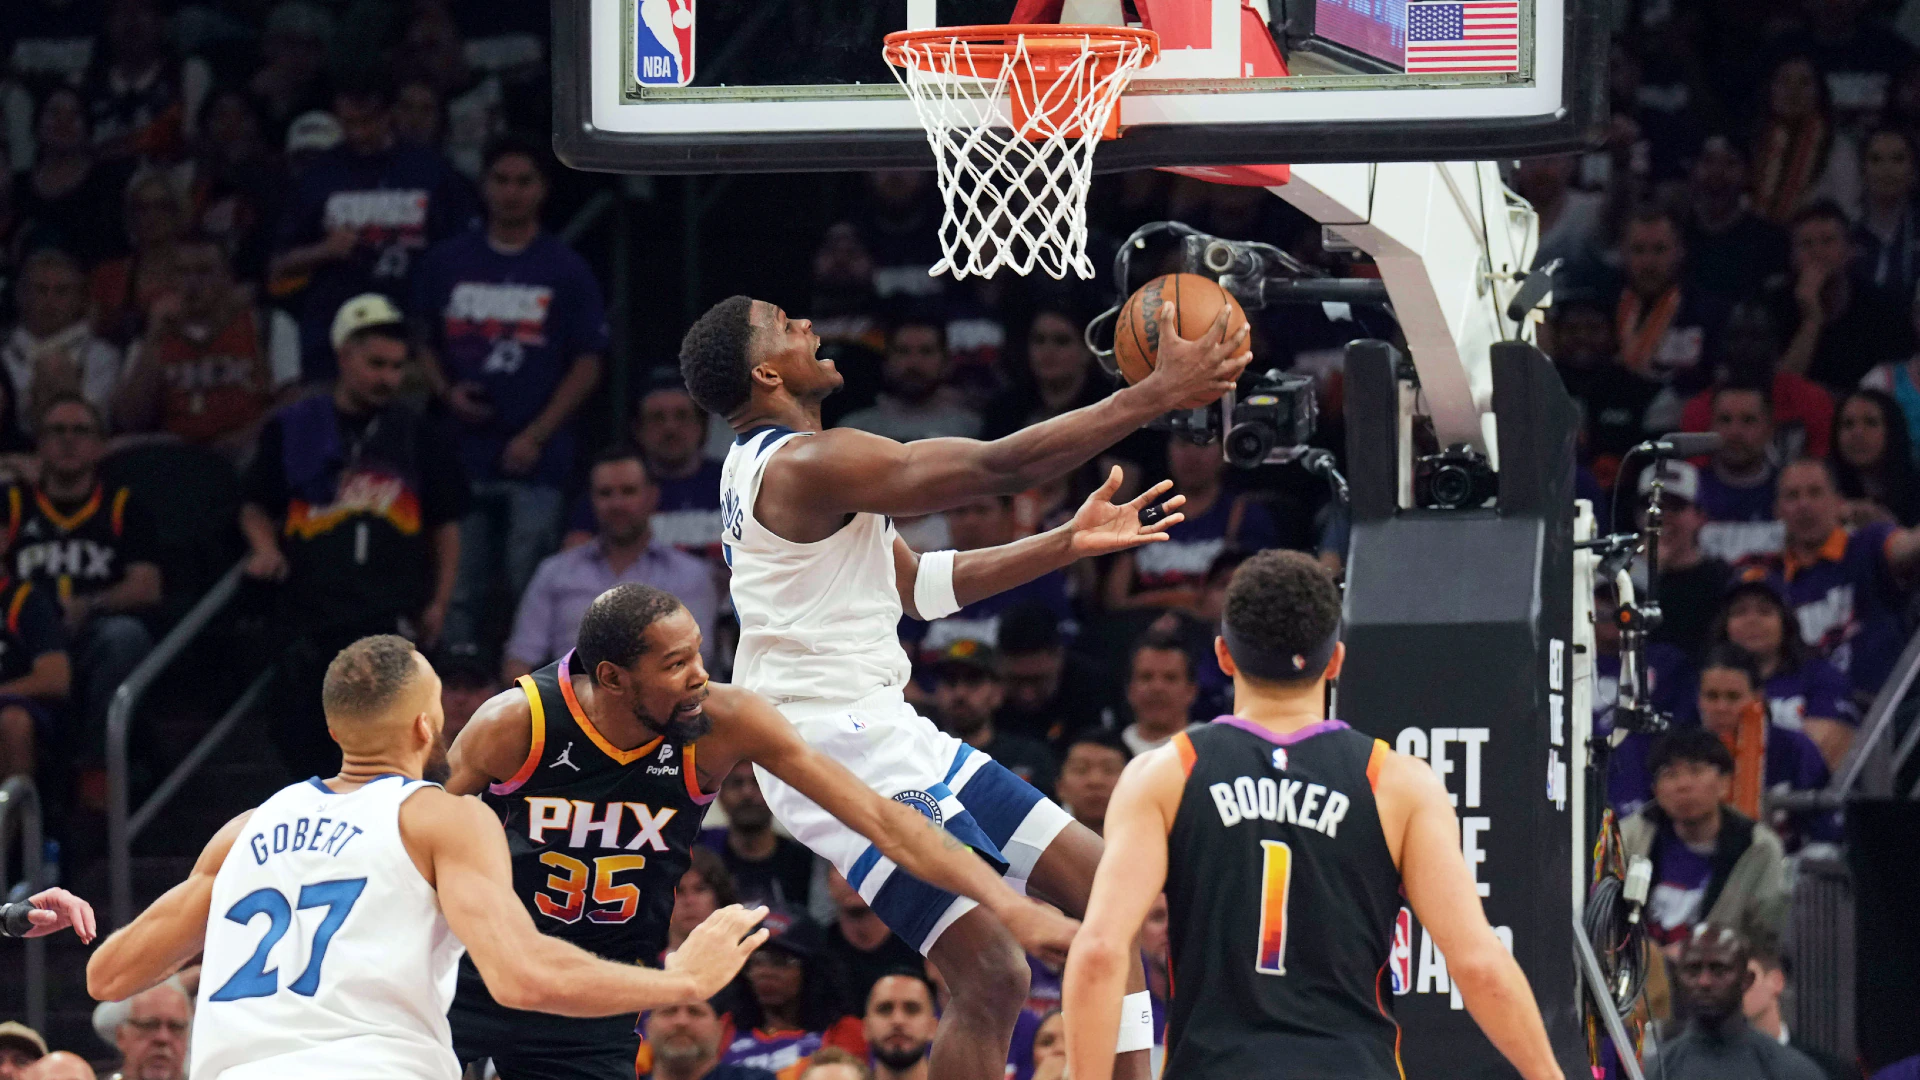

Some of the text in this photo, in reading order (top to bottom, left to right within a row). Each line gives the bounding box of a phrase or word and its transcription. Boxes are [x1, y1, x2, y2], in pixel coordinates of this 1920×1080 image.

[643, 56, 672, 78] NBA
[16, 539, 117, 580] PHX
[645, 765, 679, 776] PayPal
[523, 796, 678, 852] PHX
[1208, 775, 1351, 840] BOOKER
[250, 817, 364, 866] GOBERT
[533, 850, 647, 924] 35
[1255, 839, 1293, 977] 1
[208, 876, 369, 1002] 27
[1141, 1010, 1150, 1024] 5
